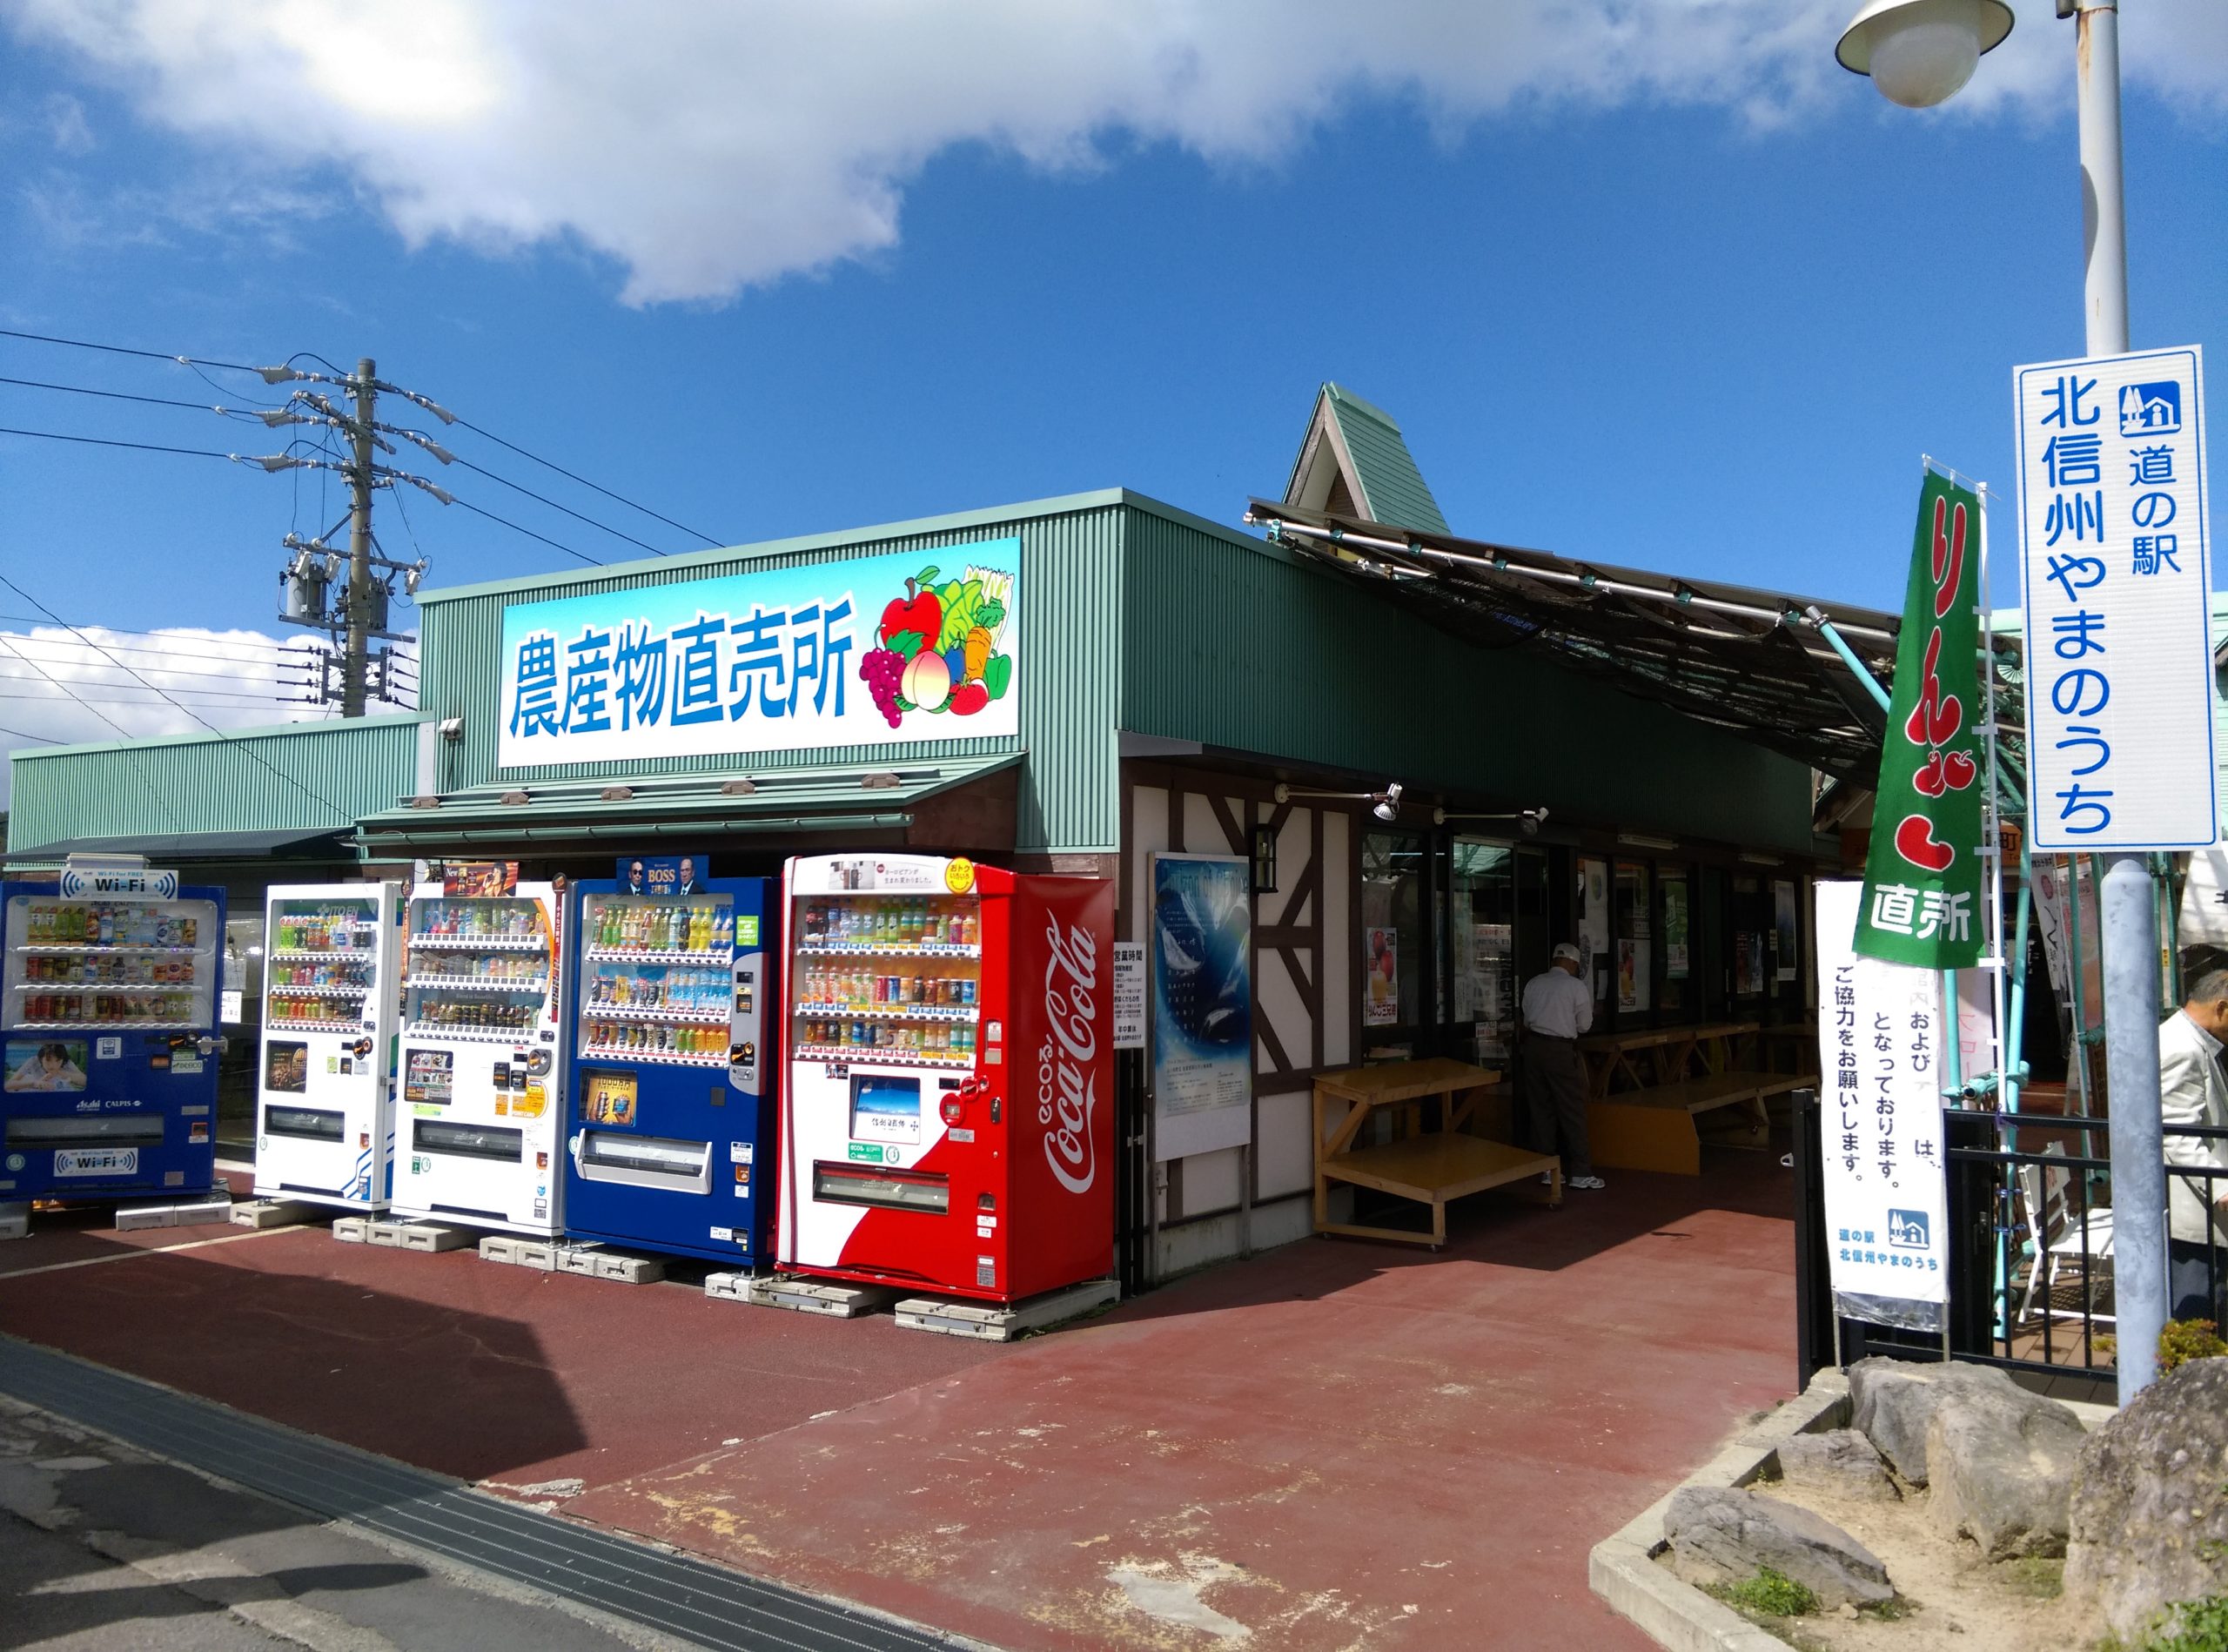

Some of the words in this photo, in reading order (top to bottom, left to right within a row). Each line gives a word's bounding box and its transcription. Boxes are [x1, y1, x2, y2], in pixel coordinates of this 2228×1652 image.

[2129, 445, 2182, 575] 道の駅
[2041, 375, 2114, 834] 北信州やまのうち
[509, 600, 853, 738] 農産物直売所
[1895, 494, 1977, 872] りんご
[95, 878, 145, 892] Wi-Fi
[648, 869, 676, 883] BOSS
[1114, 950, 1143, 962] 営業時間
[1044, 908, 1097, 1195] Coca-Cola
[1835, 966, 1862, 1182] ご協力をお願いします。
[77, 1099, 100, 1109] Asahi
[105, 1099, 131, 1108] CALPIS
[77, 1156, 117, 1168] Wi-Fi
[1839, 1228, 1875, 1243] 道の駅
[1840, 1248, 1938, 1272] 北信州やまのうち
